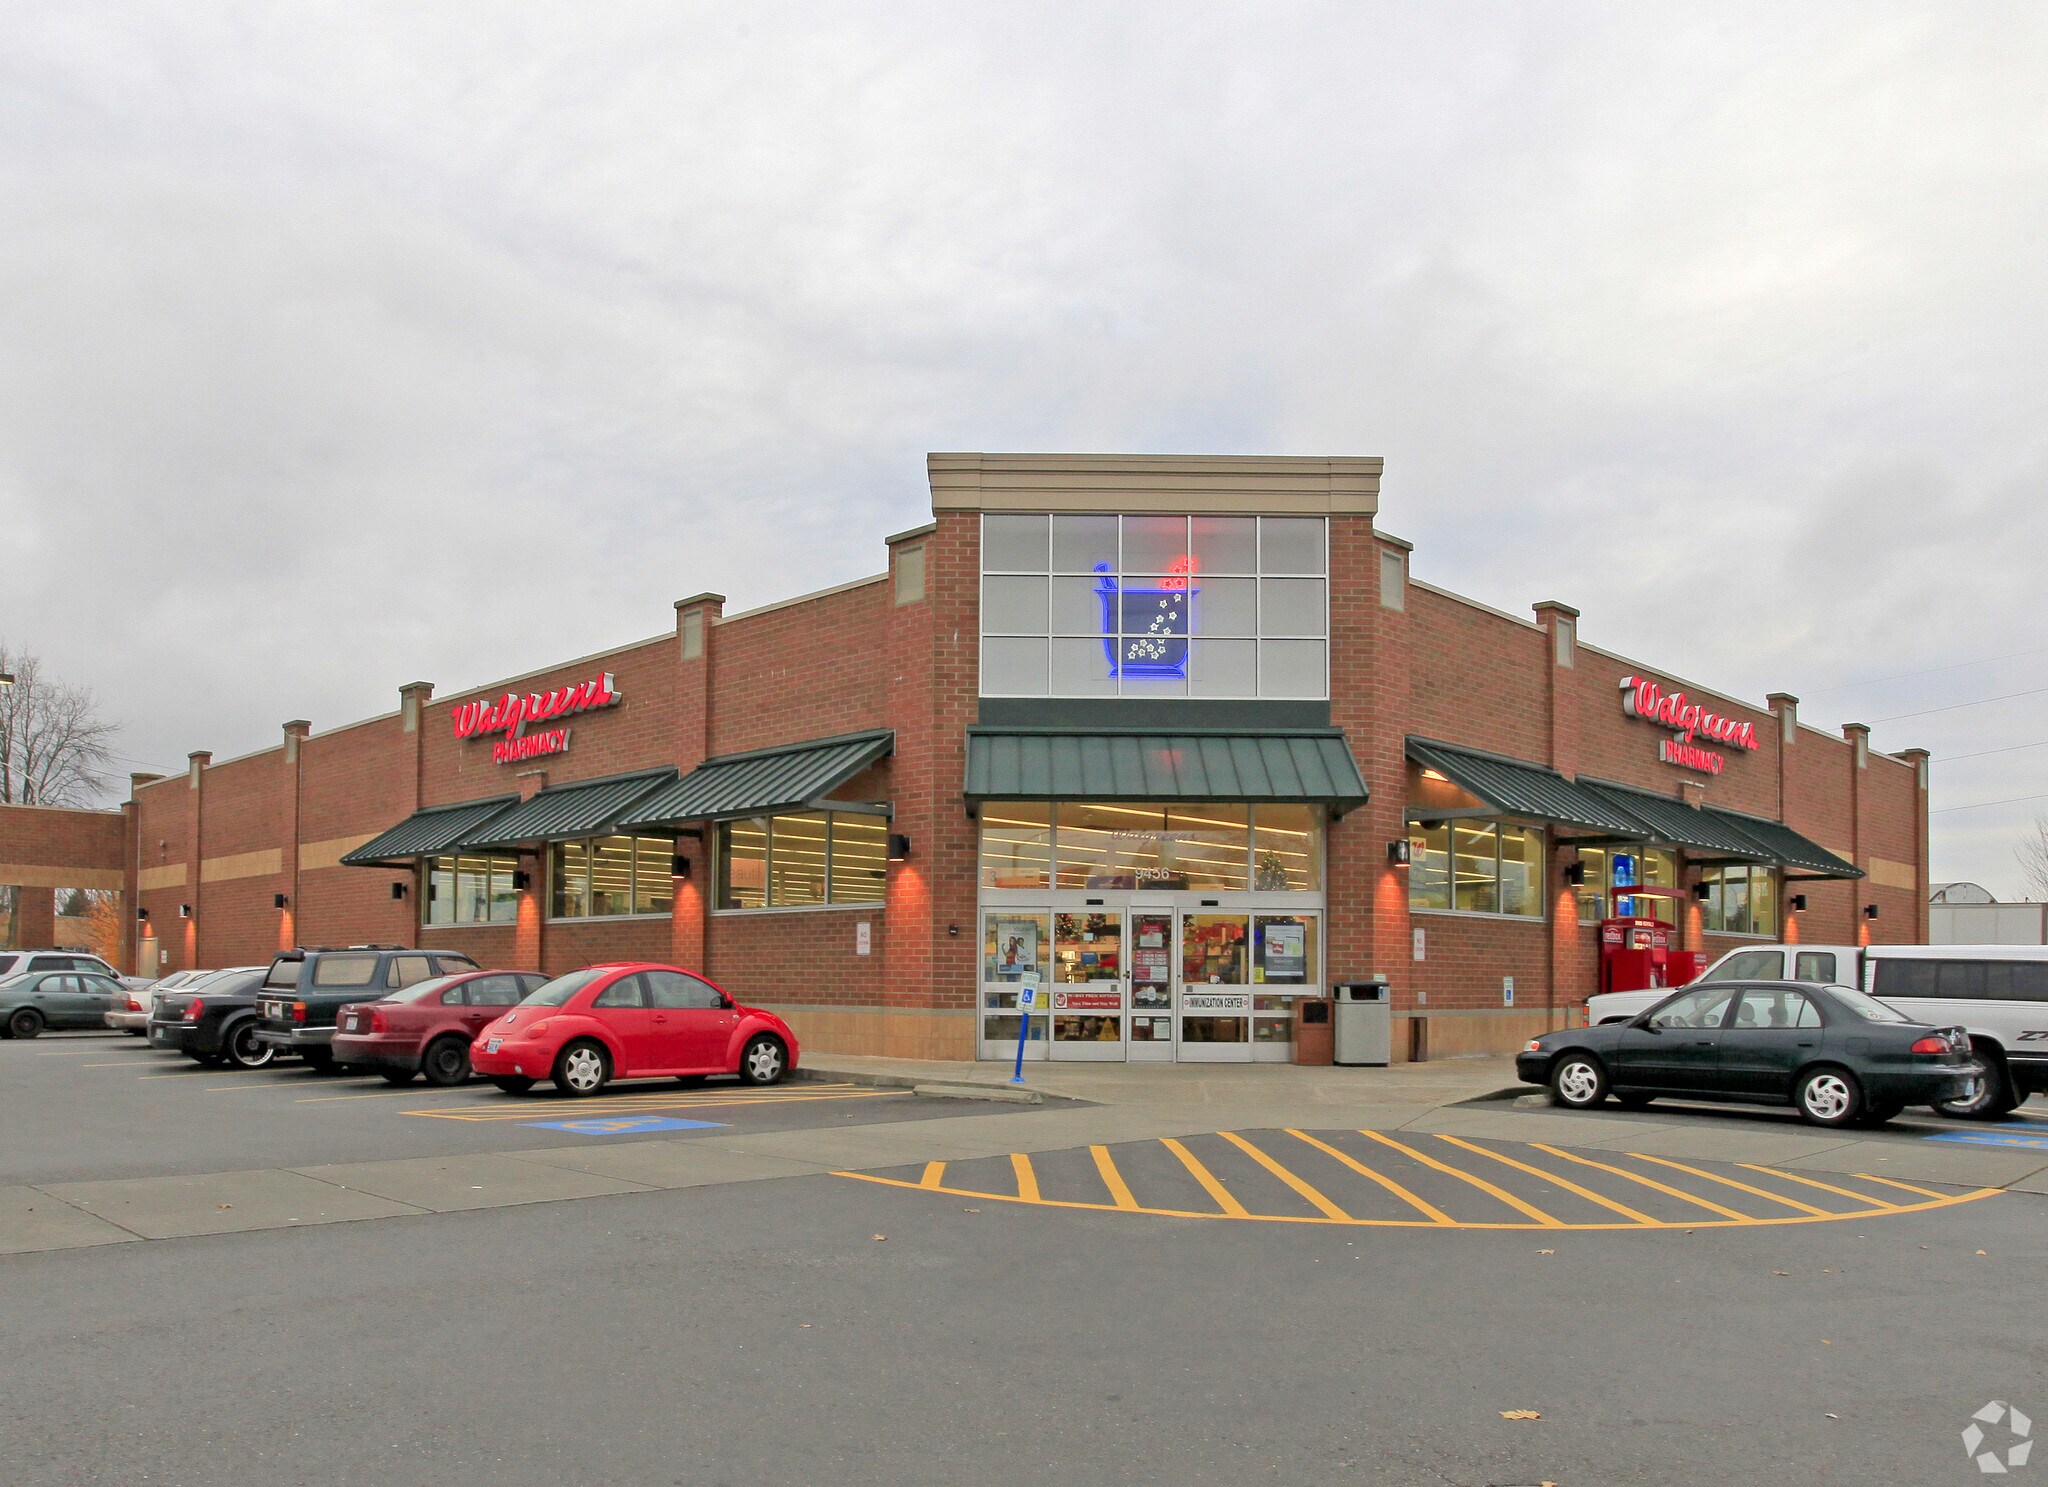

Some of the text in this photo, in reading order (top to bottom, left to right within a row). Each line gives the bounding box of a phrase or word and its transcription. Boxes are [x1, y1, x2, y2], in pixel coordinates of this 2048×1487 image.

[452, 672, 618, 740] Walgreens
[1624, 676, 1760, 750] Walgreens
[493, 728, 569, 763] PHARMACY
[1663, 740, 1725, 774] PHARMACY
[1134, 866, 1170, 880] 9456
[1605, 931, 1621, 941] redbox
[1189, 997, 1243, 1008] IMMUNIZATION CENTER
